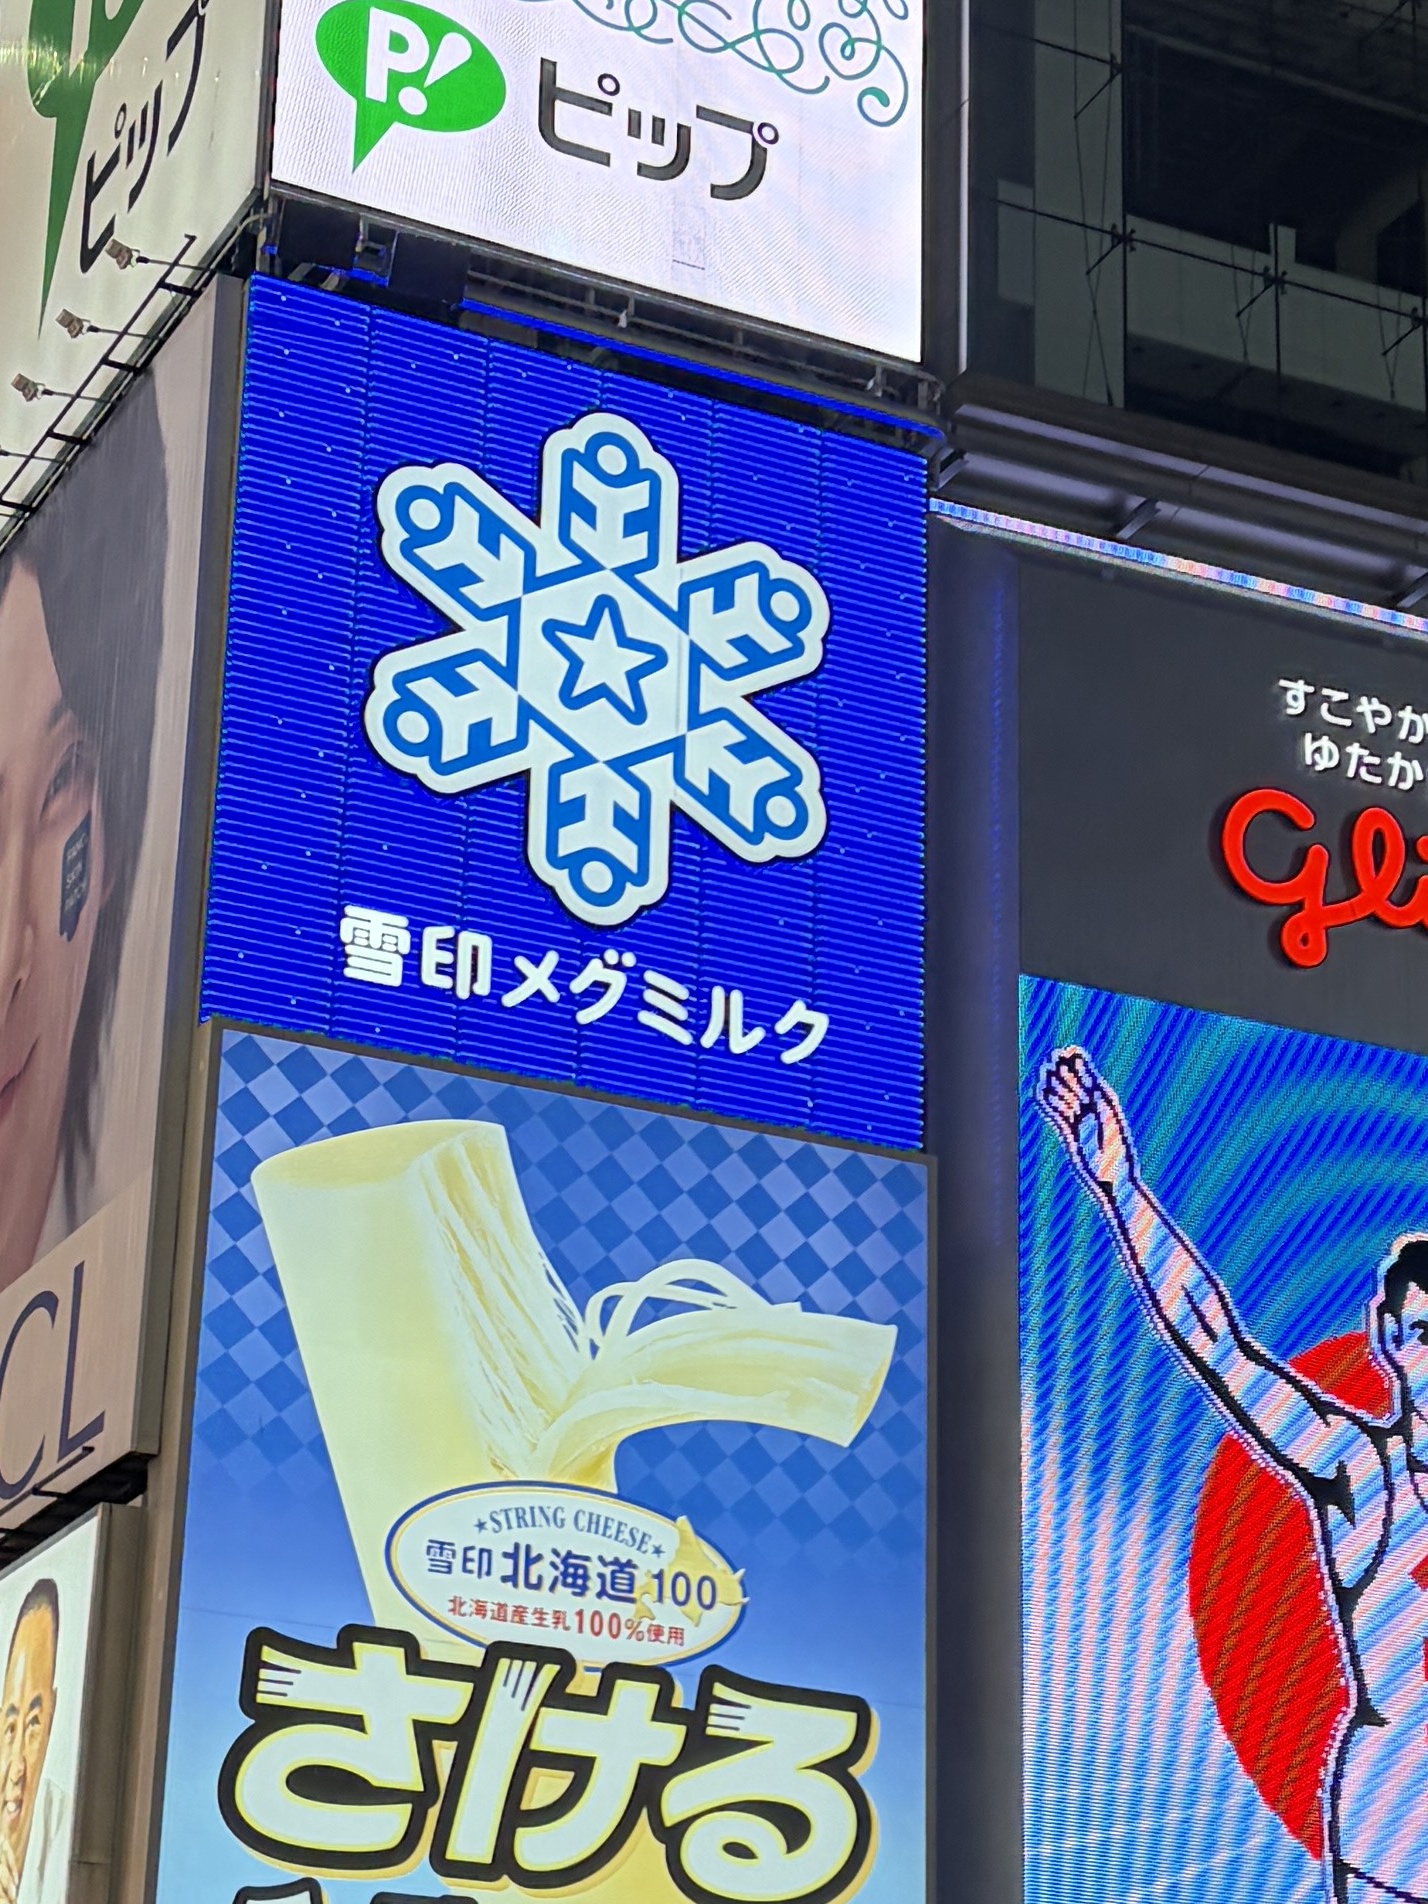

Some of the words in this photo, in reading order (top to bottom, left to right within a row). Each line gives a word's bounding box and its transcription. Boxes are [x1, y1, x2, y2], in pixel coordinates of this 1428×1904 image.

[538, 57, 780, 202] ピップ
[339, 904, 831, 1066] 雪印メグミルク
[489, 1505, 566, 1535] STRING
[573, 1509, 650, 1556] CHEESE
[448, 1595, 685, 1647] 北海道産生乳100%使用
